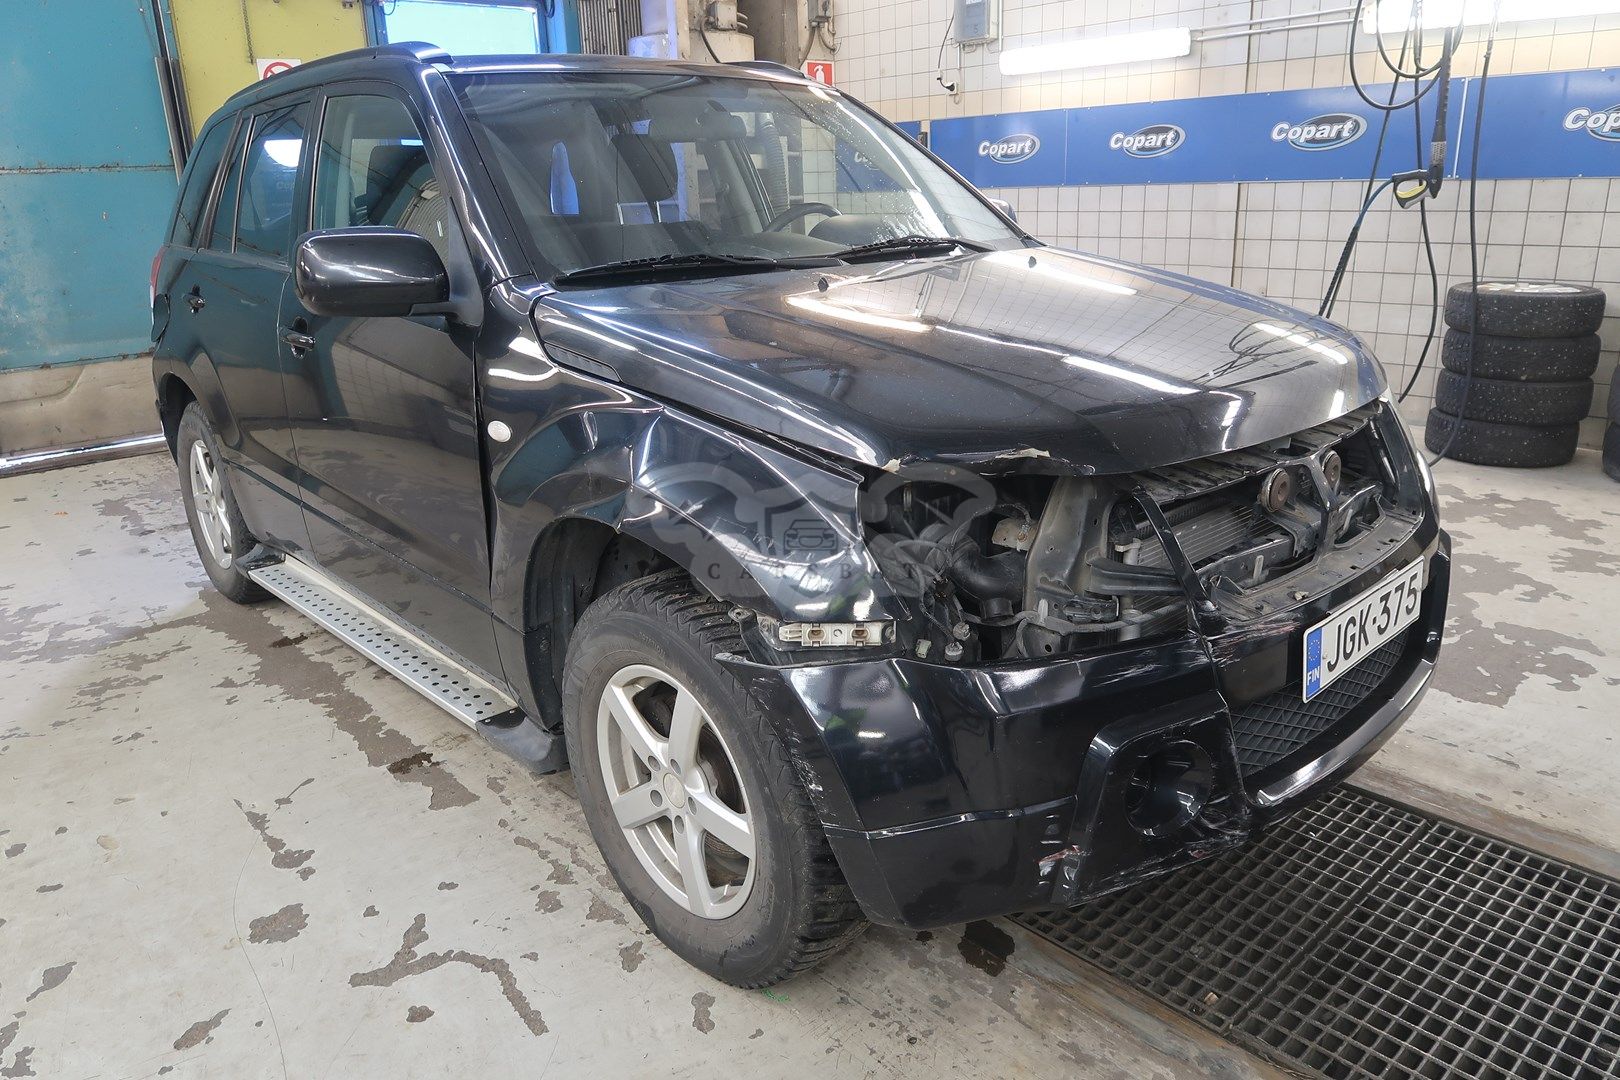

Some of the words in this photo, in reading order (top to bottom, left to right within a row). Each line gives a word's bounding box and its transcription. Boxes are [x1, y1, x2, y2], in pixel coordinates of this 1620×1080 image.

[1110, 128, 1176, 150] Copart
[1271, 119, 1355, 142] Copart
[978, 137, 1034, 157] Copart
[1327, 572, 1419, 672] JGK-375
[1307, 666, 1320, 686] FIN
